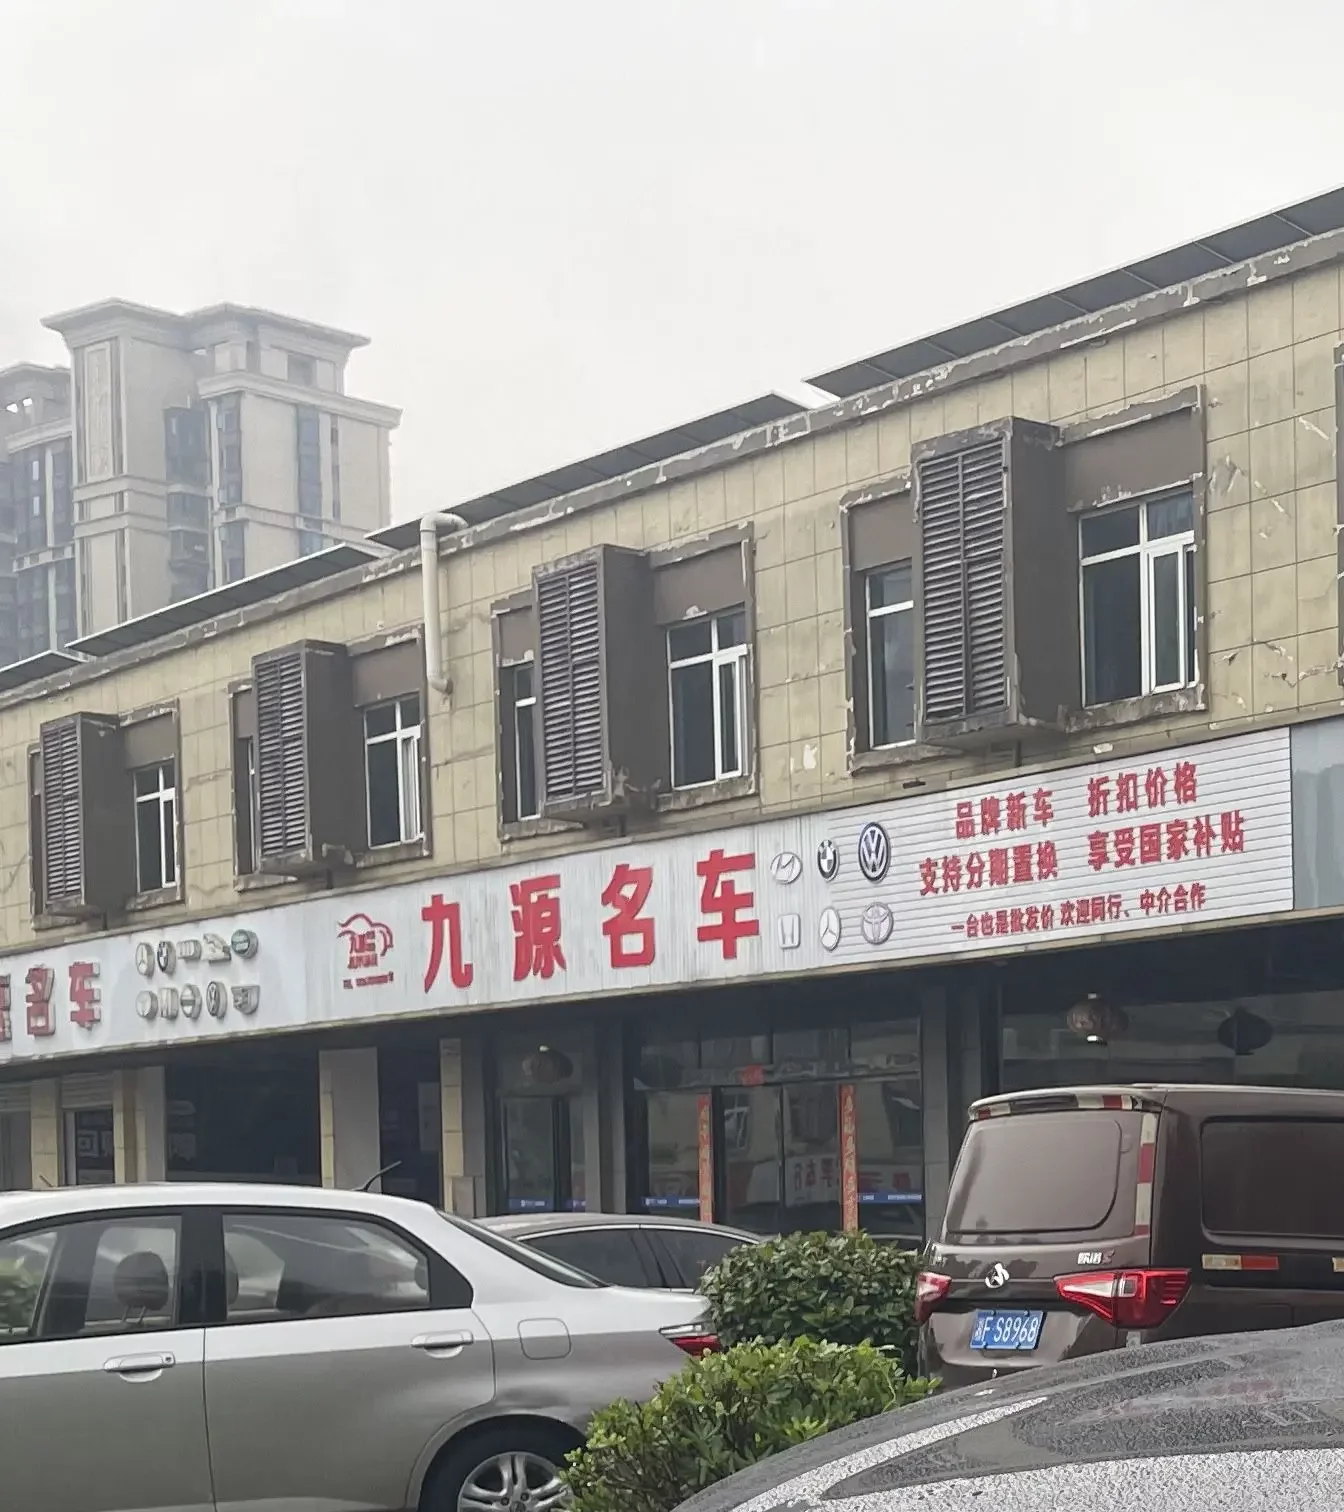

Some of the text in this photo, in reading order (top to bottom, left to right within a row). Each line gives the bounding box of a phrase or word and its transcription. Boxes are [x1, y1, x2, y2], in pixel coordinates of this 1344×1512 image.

[956, 761, 1197, 839] 品牌新车 折扣价格
[919, 809, 1245, 896] 支持分期置换 享受国家补贴
[421, 849, 760, 993] 九源名车
